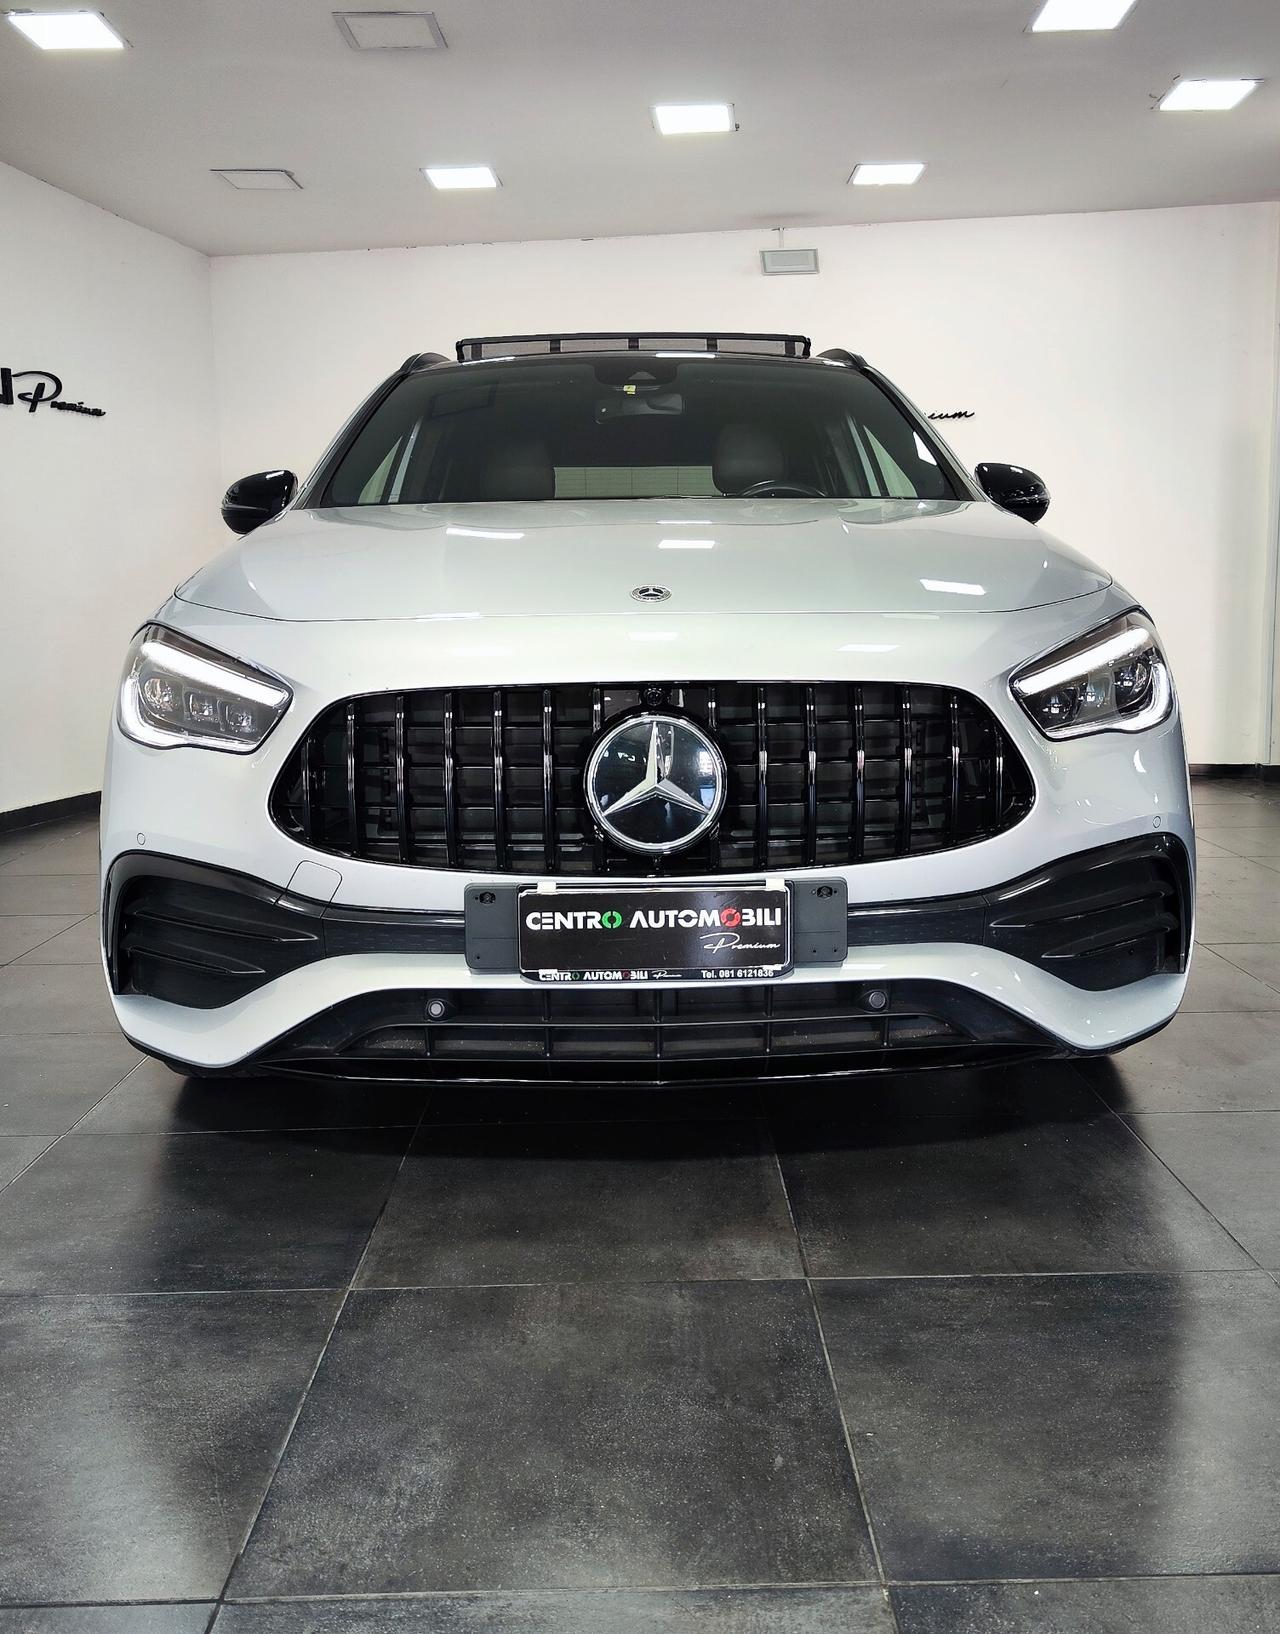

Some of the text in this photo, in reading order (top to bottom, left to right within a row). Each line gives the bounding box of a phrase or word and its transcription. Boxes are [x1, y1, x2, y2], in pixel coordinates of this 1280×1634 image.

[526, 907, 782, 929] CENTRO AUTOMOBILI
[700, 932, 780, 953] Premium
[583, 971, 649, 980] AUTOMOBILI
[701, 970, 717, 978] Tel.
[719, 969, 734, 978] 081
